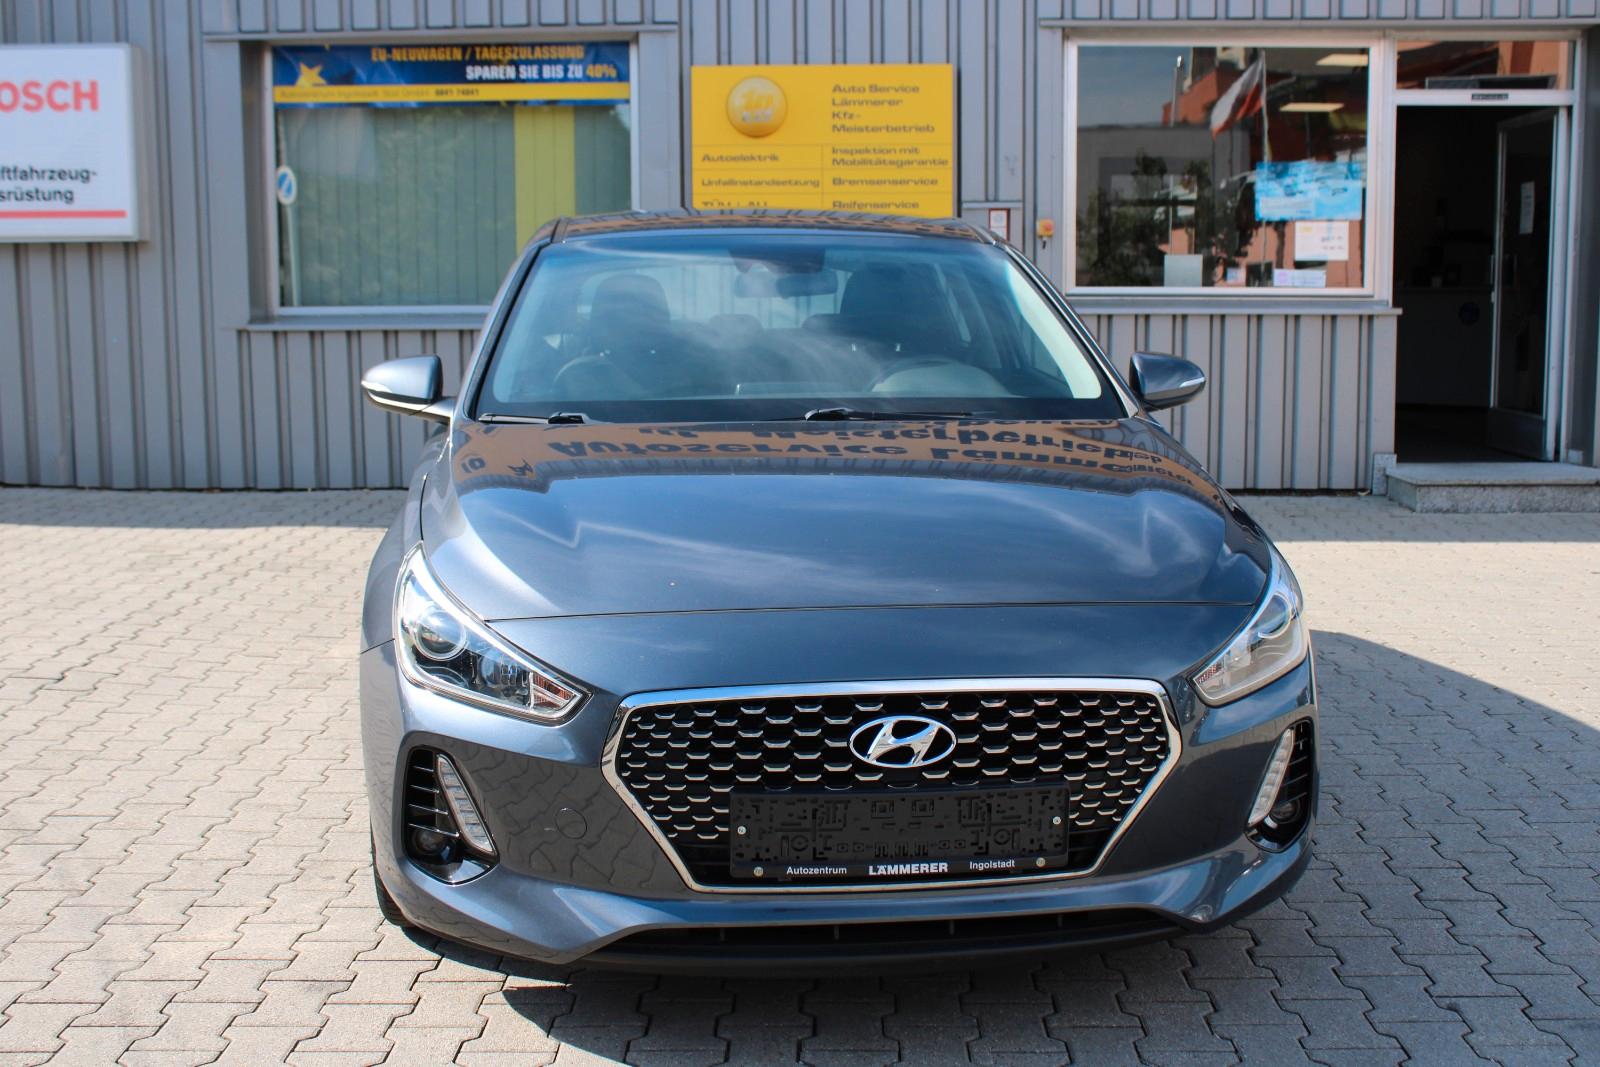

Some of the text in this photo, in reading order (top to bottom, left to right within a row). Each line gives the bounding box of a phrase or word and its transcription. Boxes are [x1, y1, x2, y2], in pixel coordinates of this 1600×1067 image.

[371, 48, 462, 61] EU-NEUWAGEN
[474, 45, 584, 60] TAGESZULASSUNG
[466, 65, 516, 80] SPAREN
[518, 64, 540, 79] SIE
[542, 64, 565, 79] BIS
[567, 64, 583, 78] ZU
[832, 84, 920, 93] Auto Service
[832, 98, 903, 107] Lämmerer
[832, 124, 936, 133] Meisterbetrieb
[832, 146, 920, 156] Inspektion mit
[702, 153, 779, 162] Autoelektrik
[832, 157, 949, 168] Mobilitätsgarantie
[701, 178, 820, 188] Unfallinstandsetzung
[832, 177, 939, 186] Bremsenservice
[832, 200, 920, 210] Reifenservice
[786, 859, 1016, 876] Autozentrum LÄMMERER Ingolstadt
